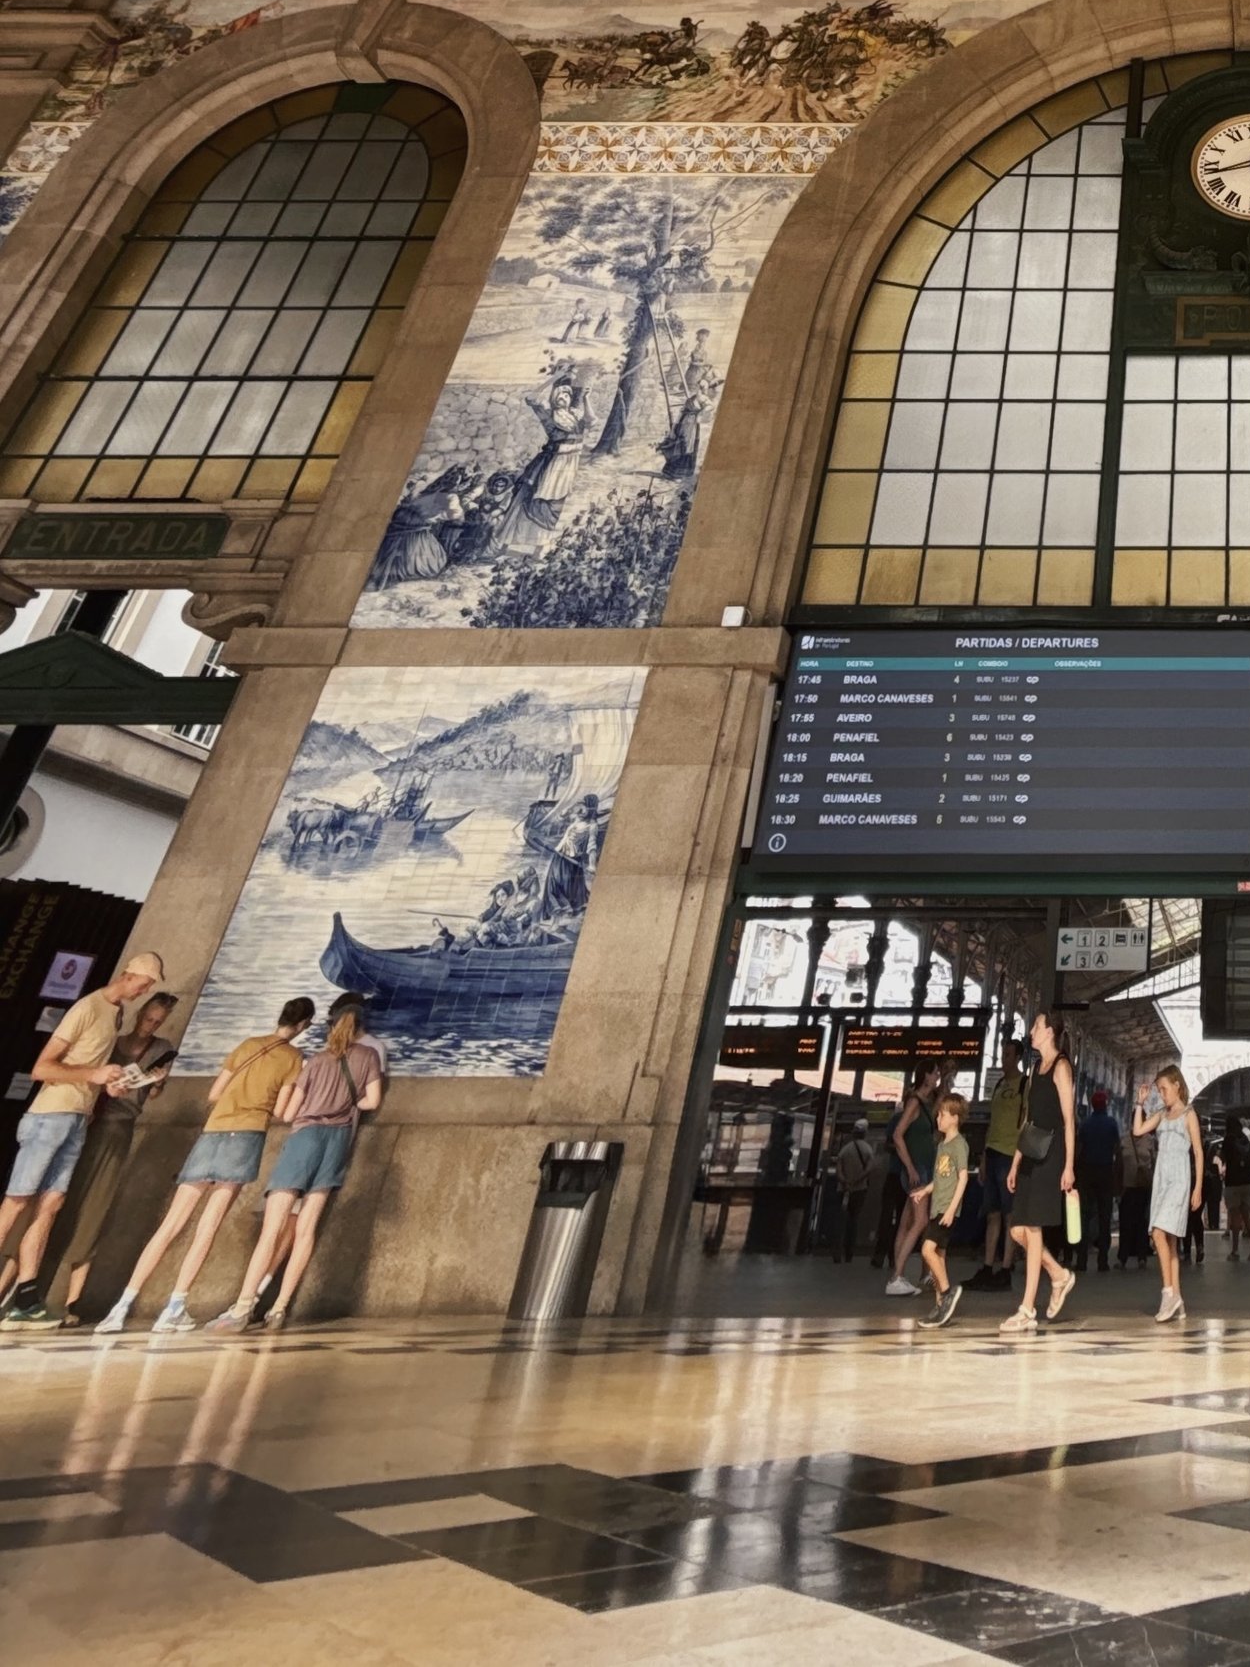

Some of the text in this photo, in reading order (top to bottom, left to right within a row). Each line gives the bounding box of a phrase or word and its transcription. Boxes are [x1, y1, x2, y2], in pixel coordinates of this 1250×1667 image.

[25, 520, 208, 552] ENTRADA
[956, 638, 1012, 648] PARTIDAS
[1022, 638, 1098, 648] DEPARTURES
[799, 676, 821, 684] 17:45
[844, 676, 877, 684] BRAGA
[795, 694, 818, 703] 17:50
[840, 694, 875, 703] MARCO
[877, 694, 933, 703] CANAVESES
[952, 694, 956, 702] 1
[791, 714, 814, 722] 17:55
[837, 714, 872, 722] AVEIRO
[949, 714, 955, 722] 3
[787, 733, 811, 742] 18:00
[833, 733, 879, 742] PENAFIEL
[947, 733, 952, 741] 6
[783, 753, 807, 762] 18:15
[830, 753, 864, 762] BRAGA
[944, 753, 950, 762] 3
[780, 773, 803, 782] 18:20
[827, 773, 873, 782] PENAFIEL
[943, 773, 947, 782] 1
[776, 794, 799, 803] 18:25
[823, 793, 881, 803] GUIMARÃES
[939, 794, 945, 803] 2
[771, 815, 795, 824] 18:30
[819, 815, 856, 824] MARCO
[858, 815, 917, 824] CANAVESES
[937, 815, 942, 824] 5
[1082, 936, 1105, 946] 1 2
[1080, 953, 1104, 968] 3 A
